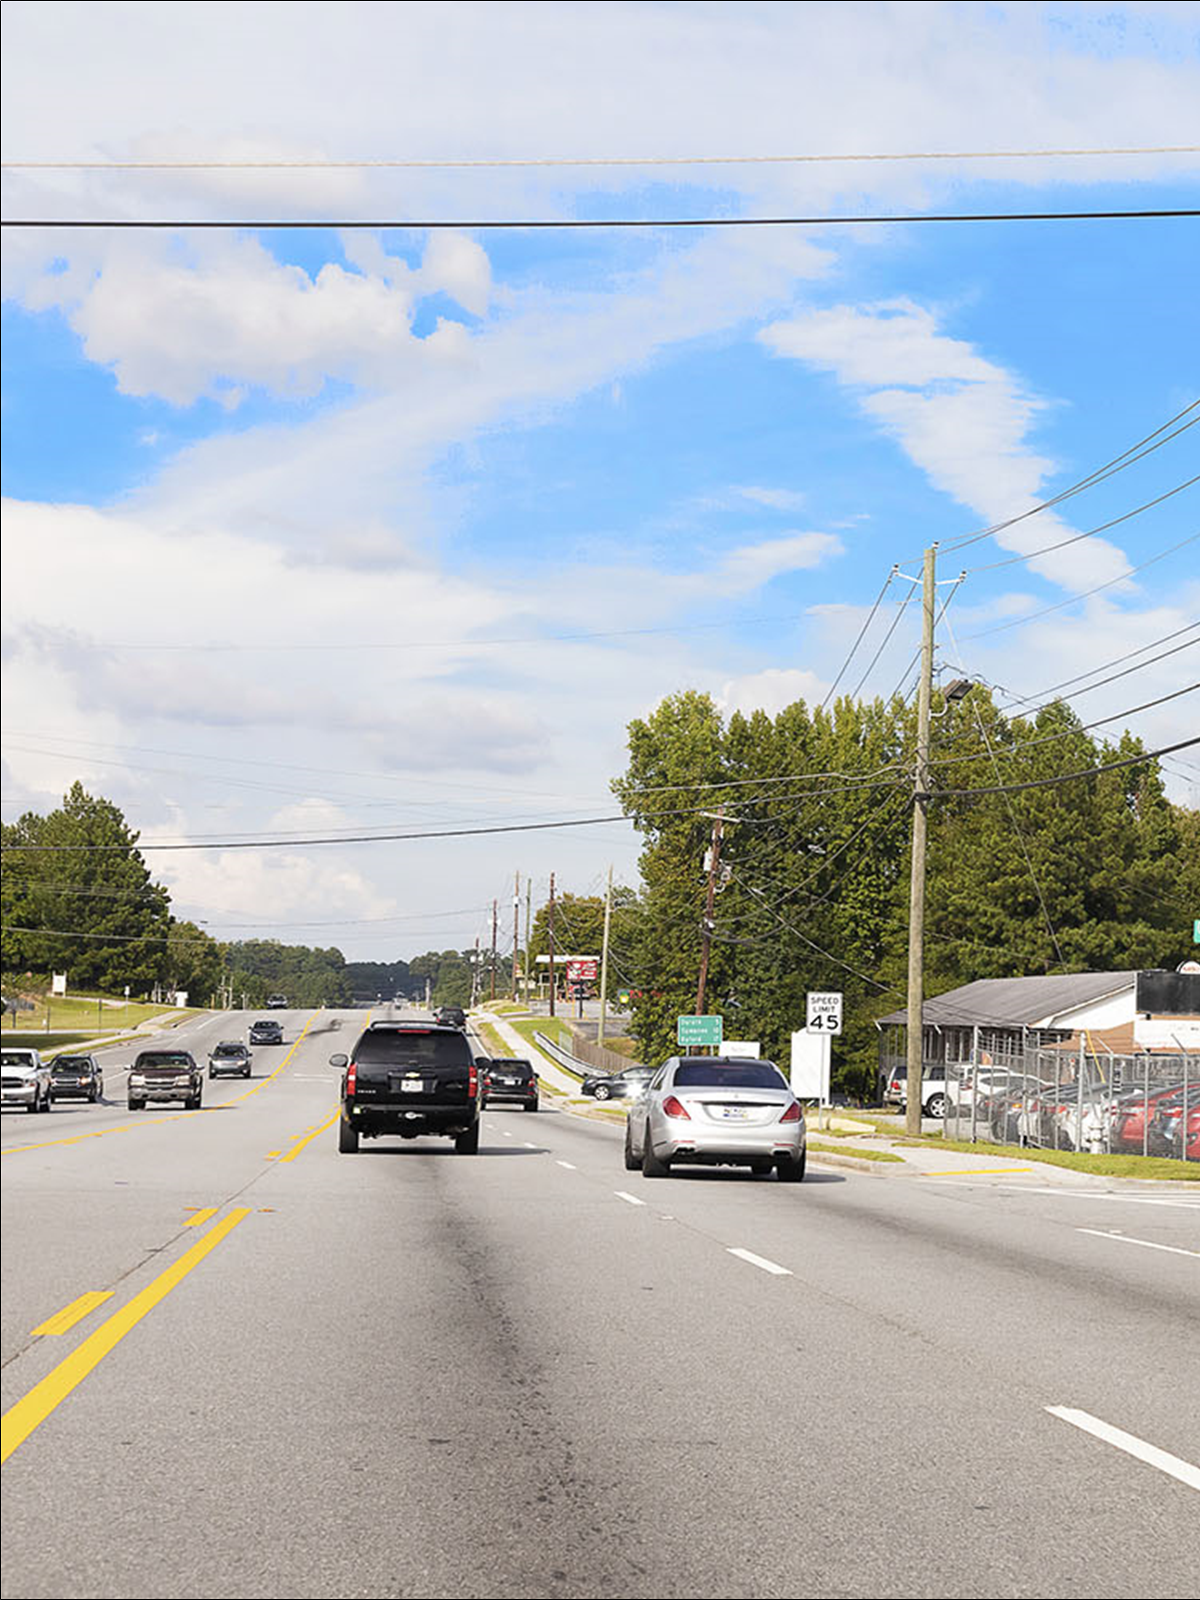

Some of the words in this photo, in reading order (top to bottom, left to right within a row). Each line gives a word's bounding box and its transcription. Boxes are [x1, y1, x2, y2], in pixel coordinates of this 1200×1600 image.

[811, 996, 839, 1005] SPEED
[812, 1005, 836, 1013] LIMIT
[809, 1014, 839, 1030] 45
